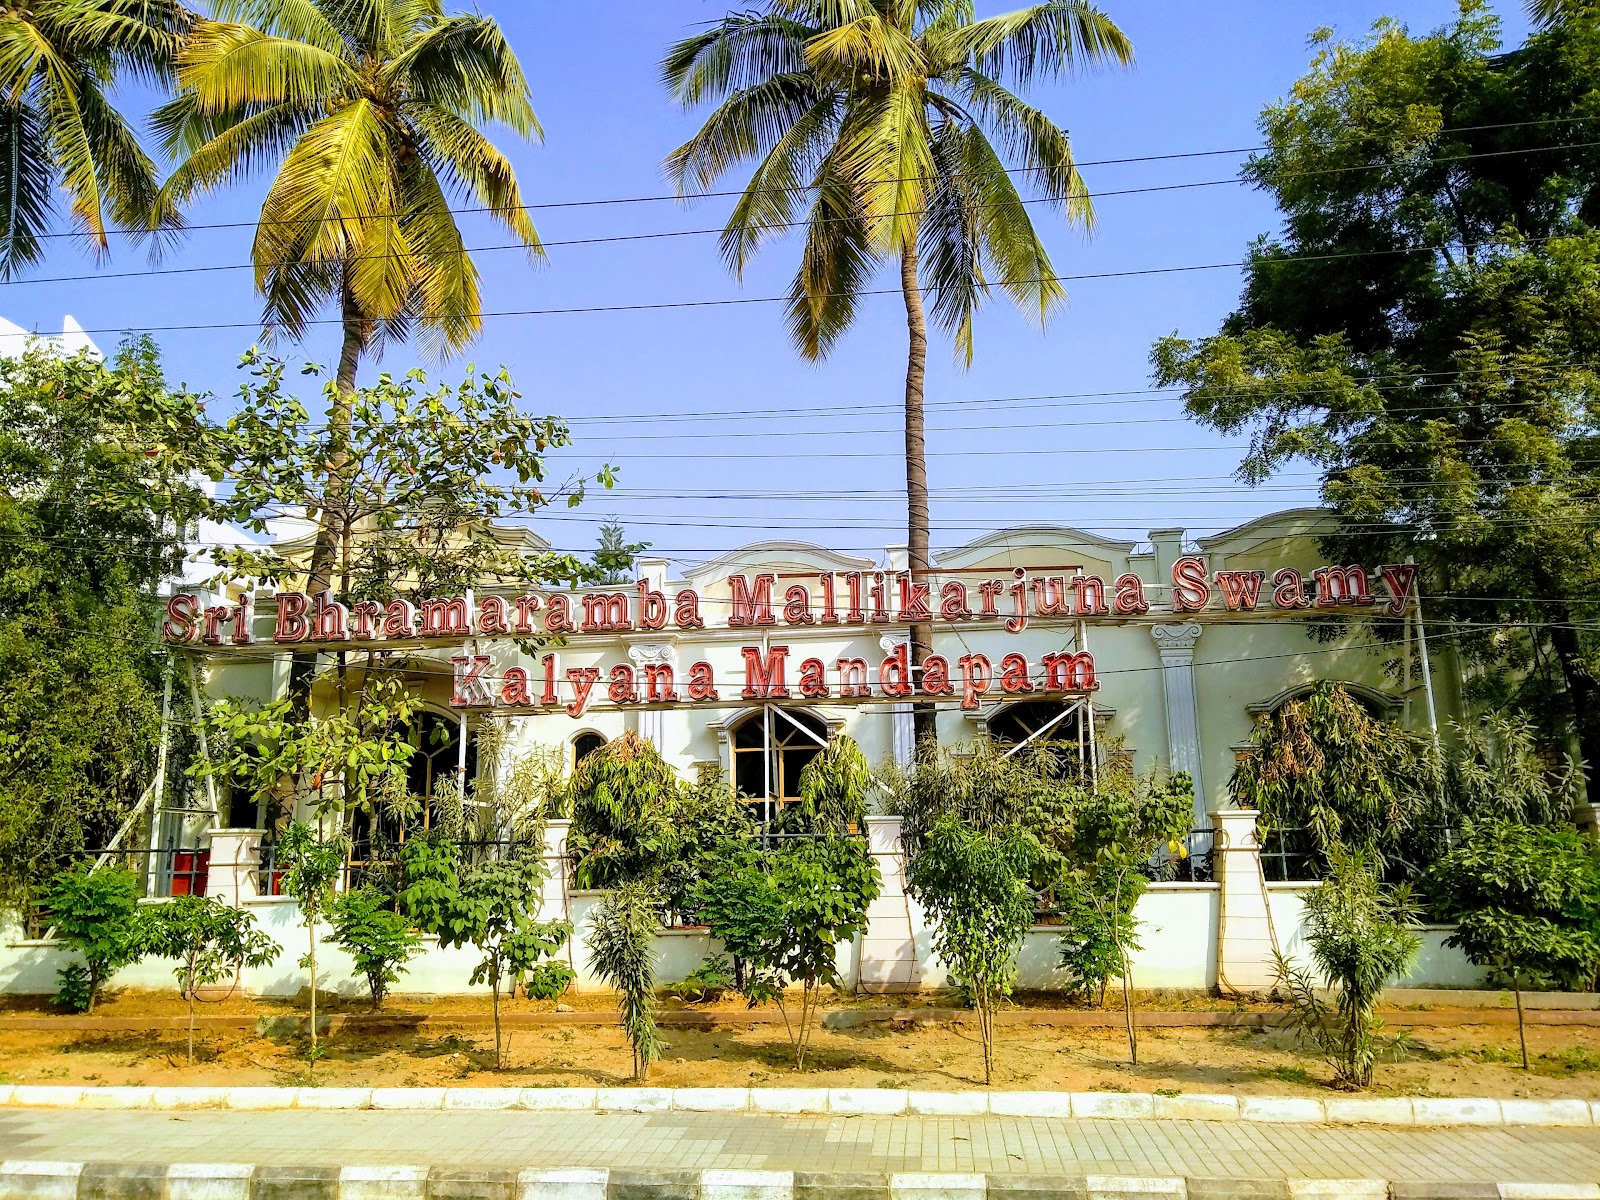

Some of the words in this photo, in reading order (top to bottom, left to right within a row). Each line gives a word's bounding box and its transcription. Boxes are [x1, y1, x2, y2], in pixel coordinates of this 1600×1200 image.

[163, 592, 255, 645] Sri
[273, 578, 705, 643] Bhramaramba
[727, 567, 1151, 634] Mallikarjuna
[1171, 556, 1419, 617] Swamy
[450, 652, 720, 718] Kalyana
[741, 642, 1101, 711] Mandapam
